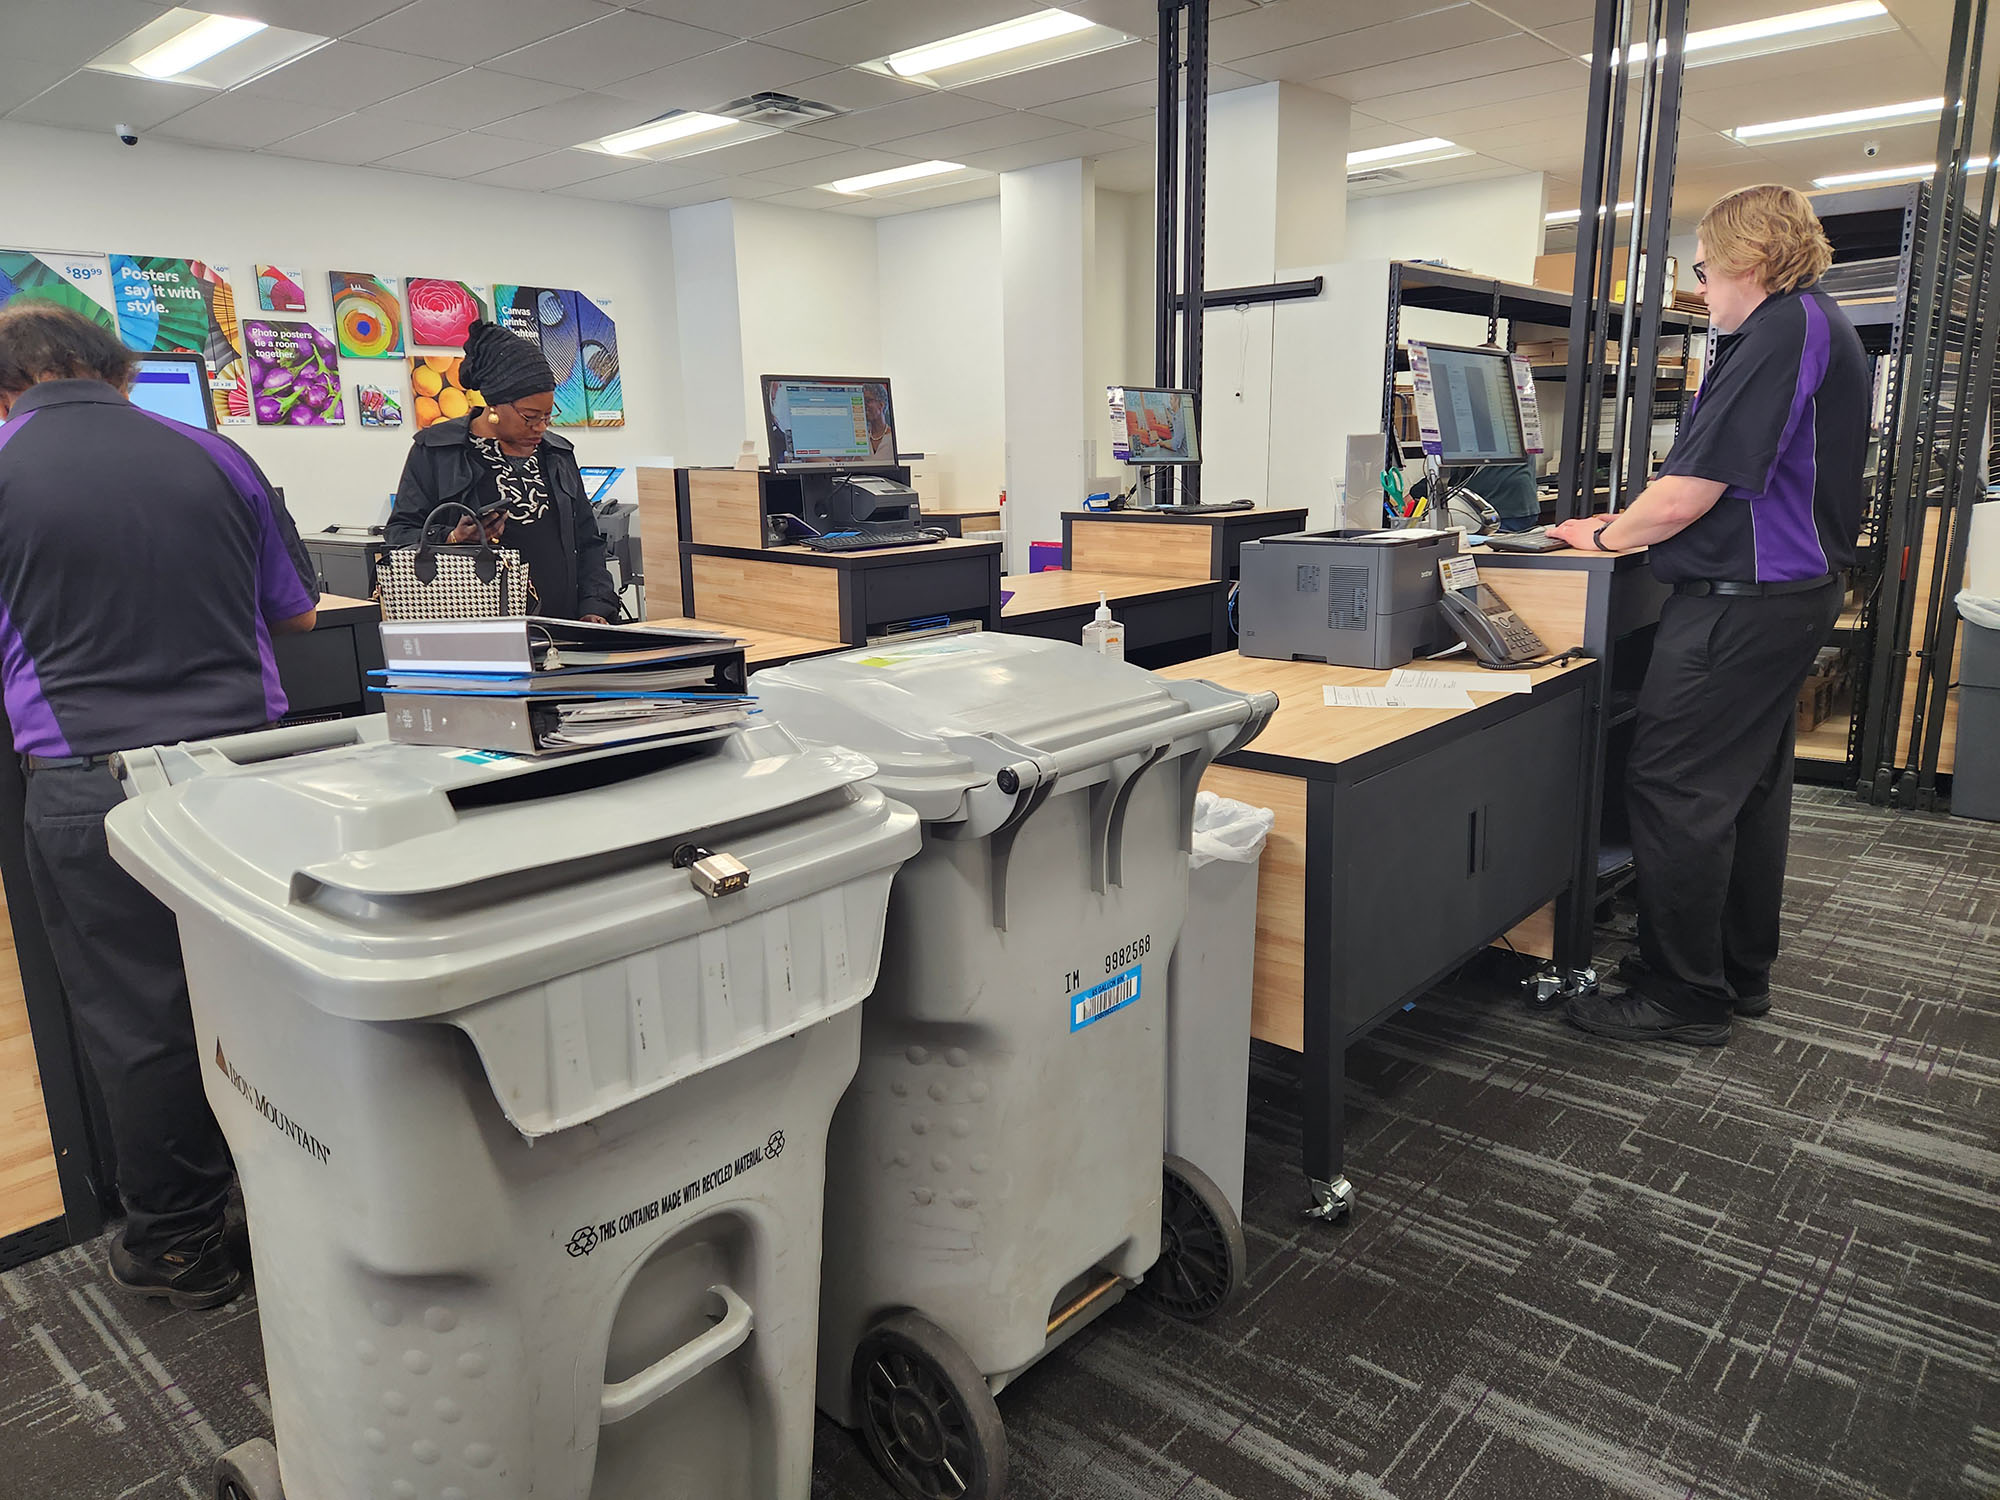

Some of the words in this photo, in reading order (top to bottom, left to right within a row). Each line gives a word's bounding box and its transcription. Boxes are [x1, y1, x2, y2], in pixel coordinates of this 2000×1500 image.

[120, 266, 180, 282] Posters
[124, 285, 150, 299] say
[153, 284, 165, 297] it
[167, 286, 201, 300] with
[127, 300, 170, 316] style.
[501, 306, 531, 316] Canvas
[503, 317, 527, 327] prints
[252, 328, 278, 338] Photo
[280, 331, 313, 340] posters
[511, 328, 539, 339] ighten
[255, 350, 295, 360] together.
[1105, 934, 1151, 974] 9982568
[1064, 969, 1080, 994] IM
[228, 1061, 253, 1105] IRON
[599, 1220, 616, 1243] THIS
[619, 1200, 660, 1234] CONTAINER
[661, 1189, 681, 1215] MADE
[683, 1179, 701, 1204] WITH
[702, 1163, 733, 1195] RECYCLED
[734, 1146, 764, 1177] MATERIAL.
